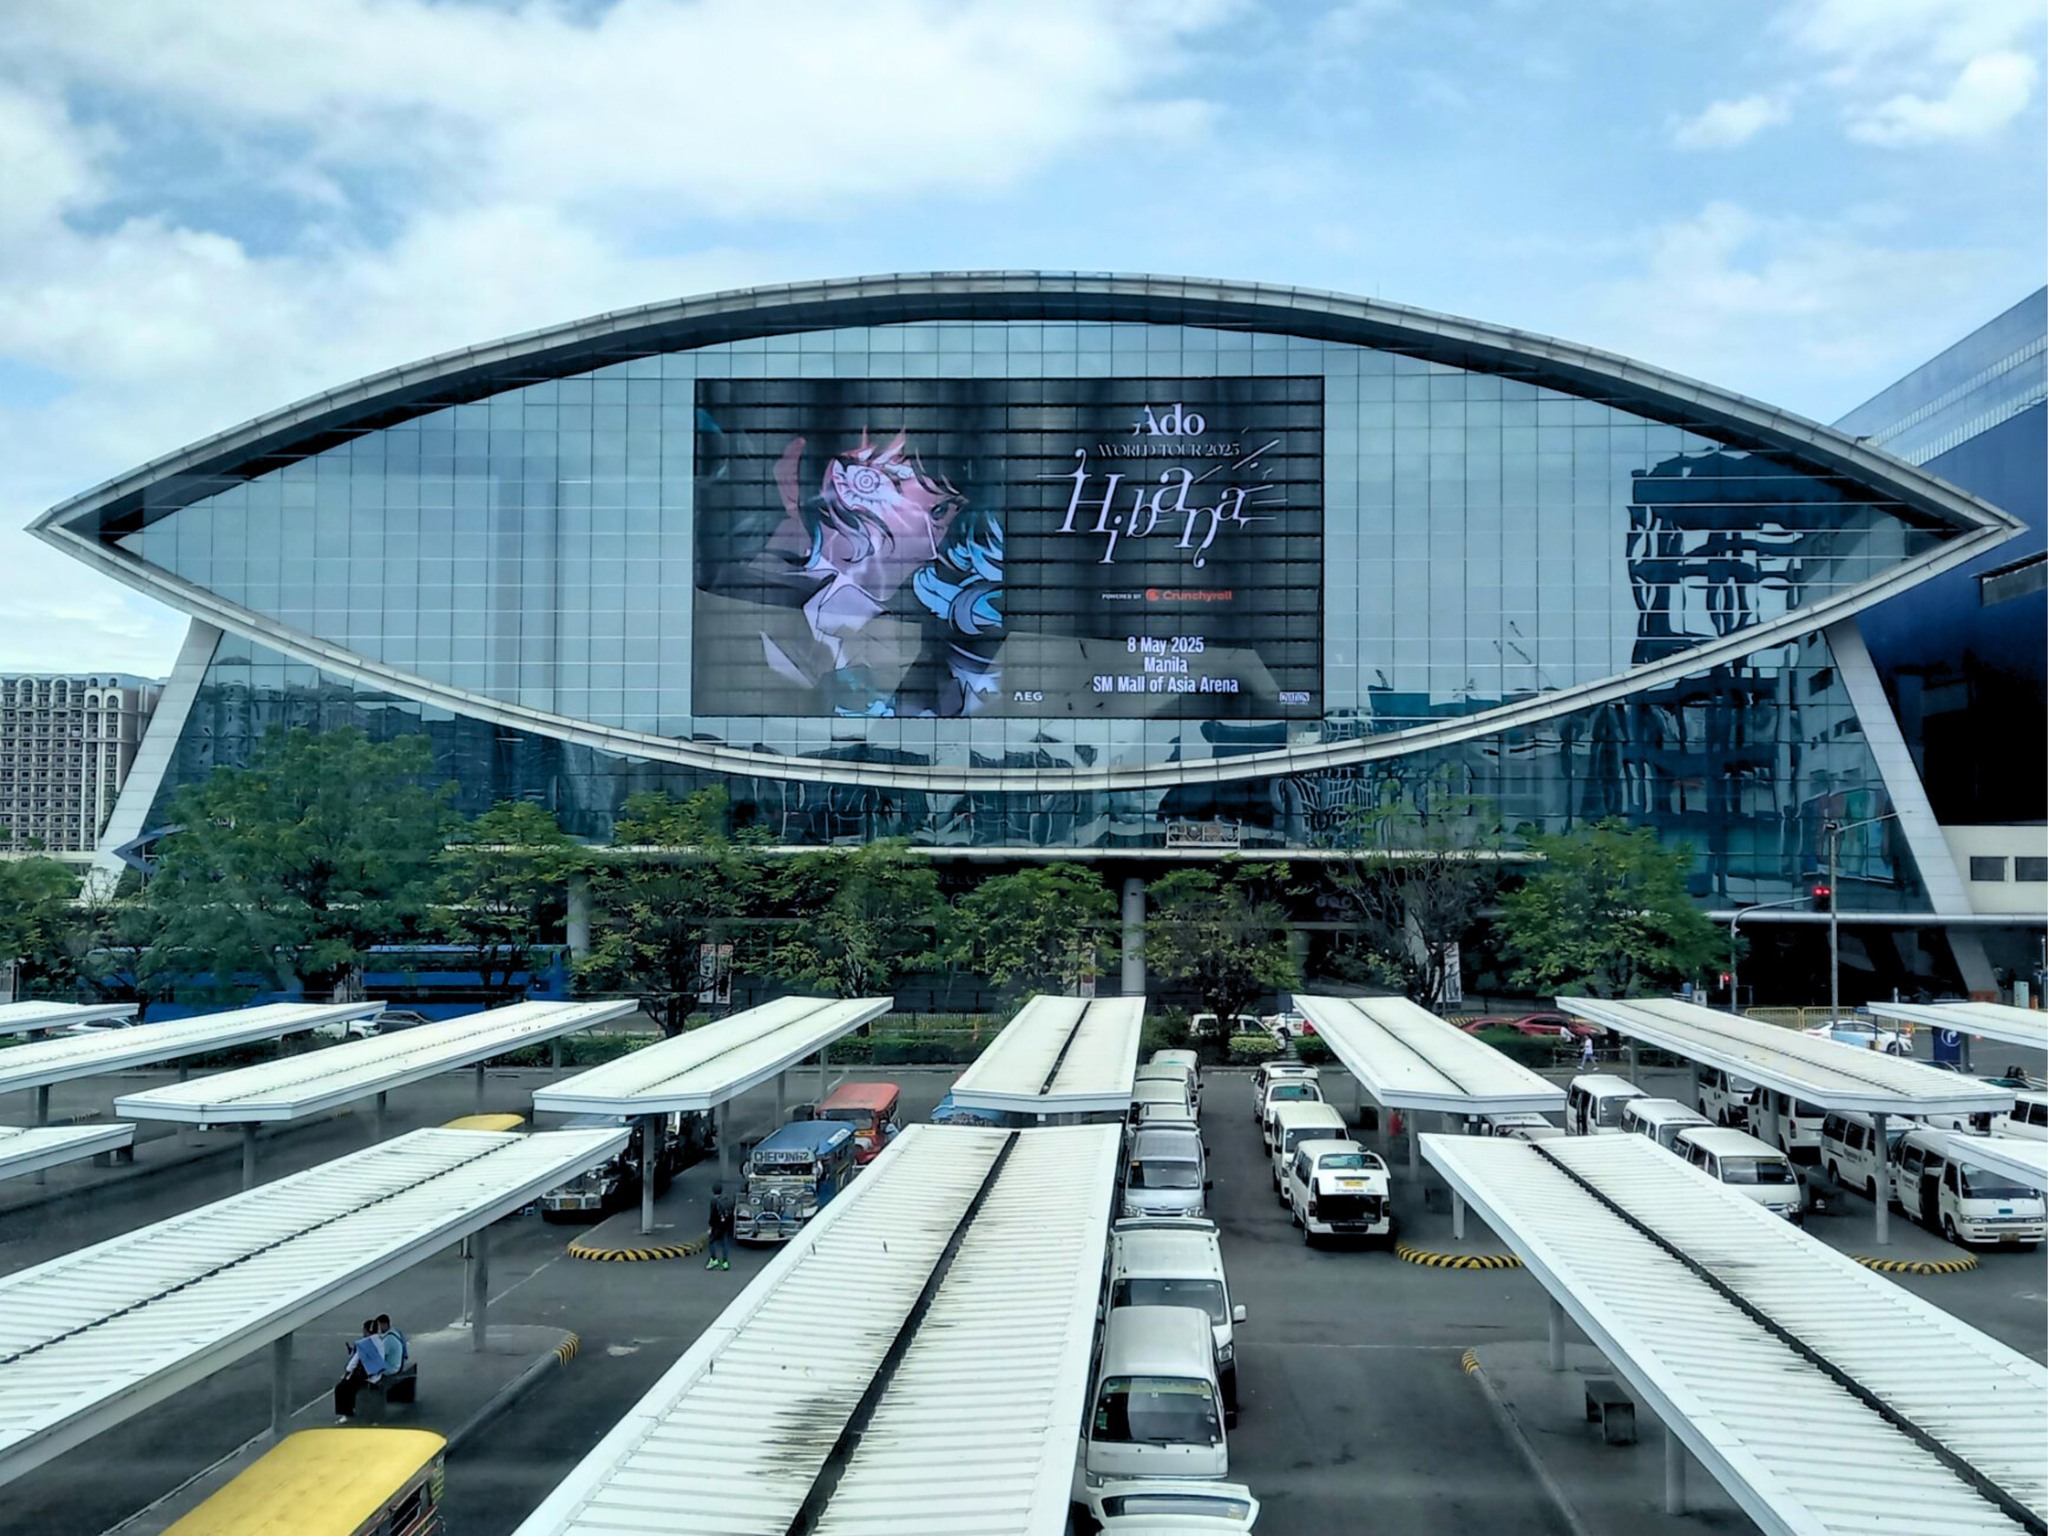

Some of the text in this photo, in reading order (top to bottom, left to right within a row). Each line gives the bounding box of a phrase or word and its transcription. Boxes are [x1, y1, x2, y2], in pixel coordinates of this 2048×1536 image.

[1132, 402, 1206, 436] Ado
[1098, 443, 1240, 457] WORLD TOUR 2025
[1037, 448, 1278, 568] Hibana
[1163, 590, 1233, 602] Crunchyroll
[1127, 636, 1204, 656] 8 May 2025
[1144, 655, 1188, 673] Manila
[1092, 675, 1239, 692] SM Mall of Asia Arena
[1013, 691, 1043, 701] AEG
